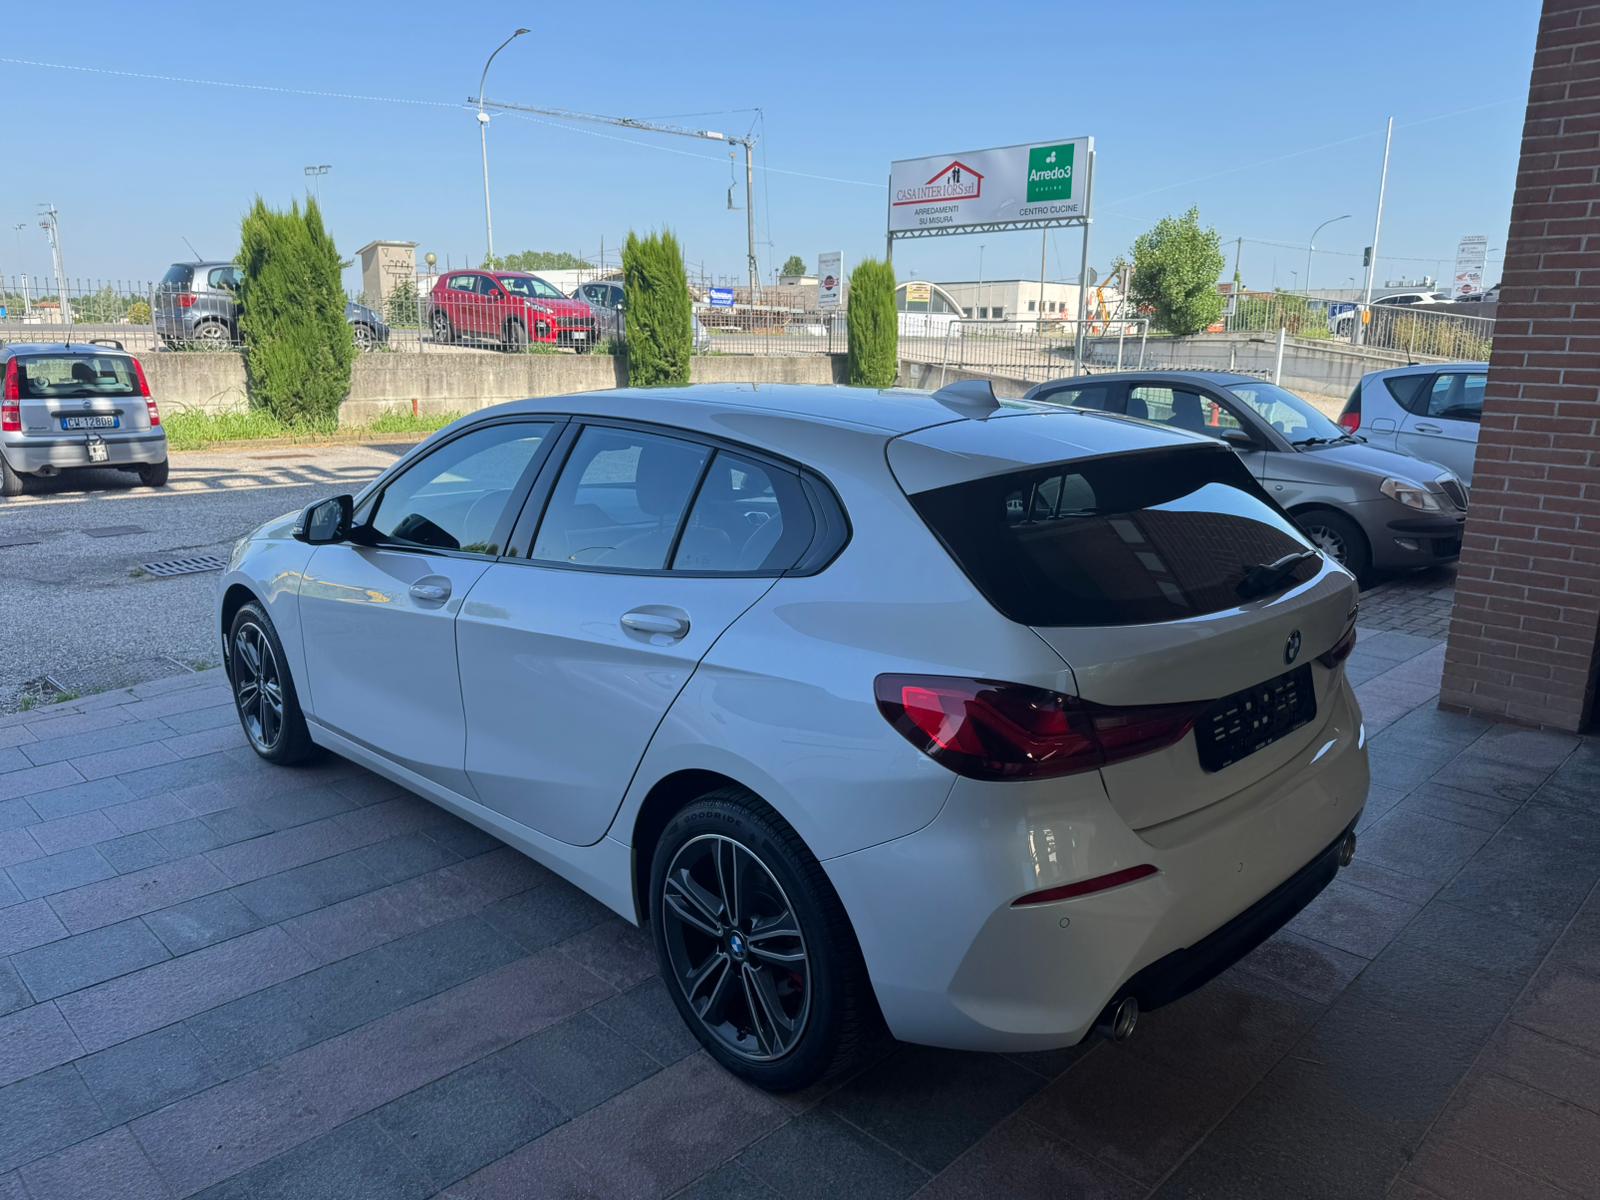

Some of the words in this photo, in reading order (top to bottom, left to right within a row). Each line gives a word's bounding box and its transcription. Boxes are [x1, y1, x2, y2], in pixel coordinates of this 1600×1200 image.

[1029, 165, 1072, 182] Arredo3
[914, 205, 959, 216] ARREDAMENTI
[1019, 206, 1048, 216] CENTRO
[1050, 203, 1078, 214] CUCINE
[919, 217, 928, 225] SU
[928, 215, 953, 224] MISURA
